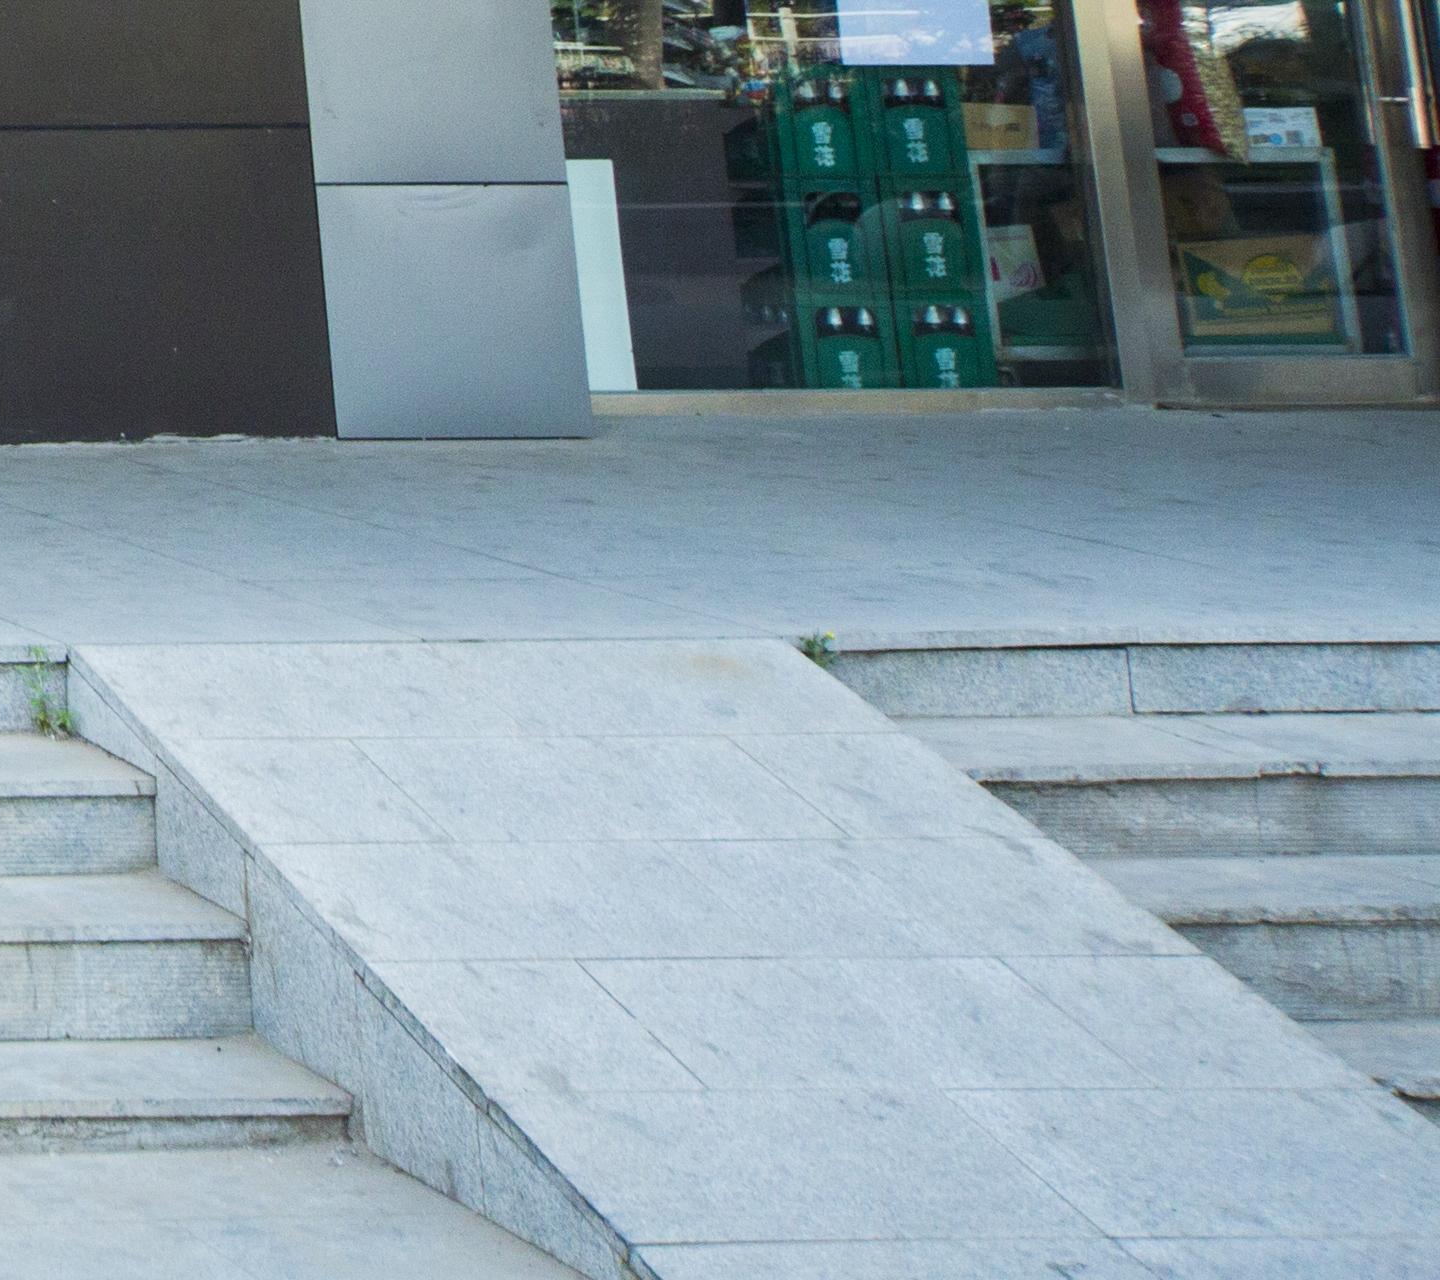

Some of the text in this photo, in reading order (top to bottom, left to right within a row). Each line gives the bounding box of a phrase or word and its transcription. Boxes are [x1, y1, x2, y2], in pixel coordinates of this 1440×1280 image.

[811, 121, 835, 167] 雪花
[903, 117, 929, 163] 雪花
[923, 231, 947, 278] 雪花
